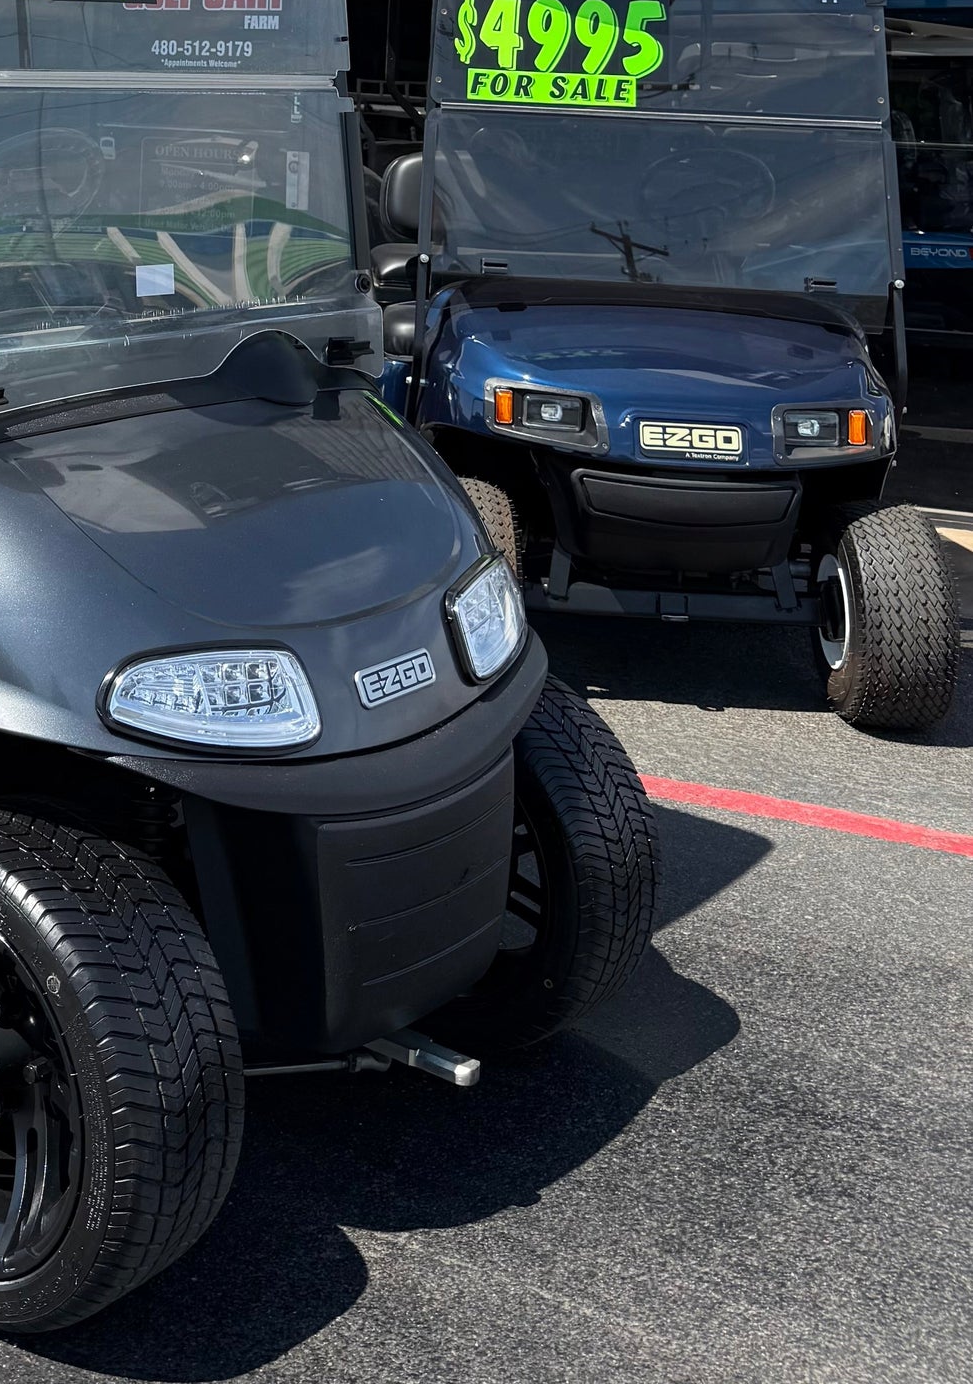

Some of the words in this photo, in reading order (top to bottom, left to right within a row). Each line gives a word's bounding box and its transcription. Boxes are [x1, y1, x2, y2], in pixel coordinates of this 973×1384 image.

[243, 15, 280, 30] FARM
[151, 39, 253, 57] 480-512-9179
[470, 72, 534, 98] FOR
[549, 75, 633, 103] SALE
[155, 145, 189, 158] OPEN
[910, 247, 967, 257] BEYOND
[713, 454, 739, 462] Company
